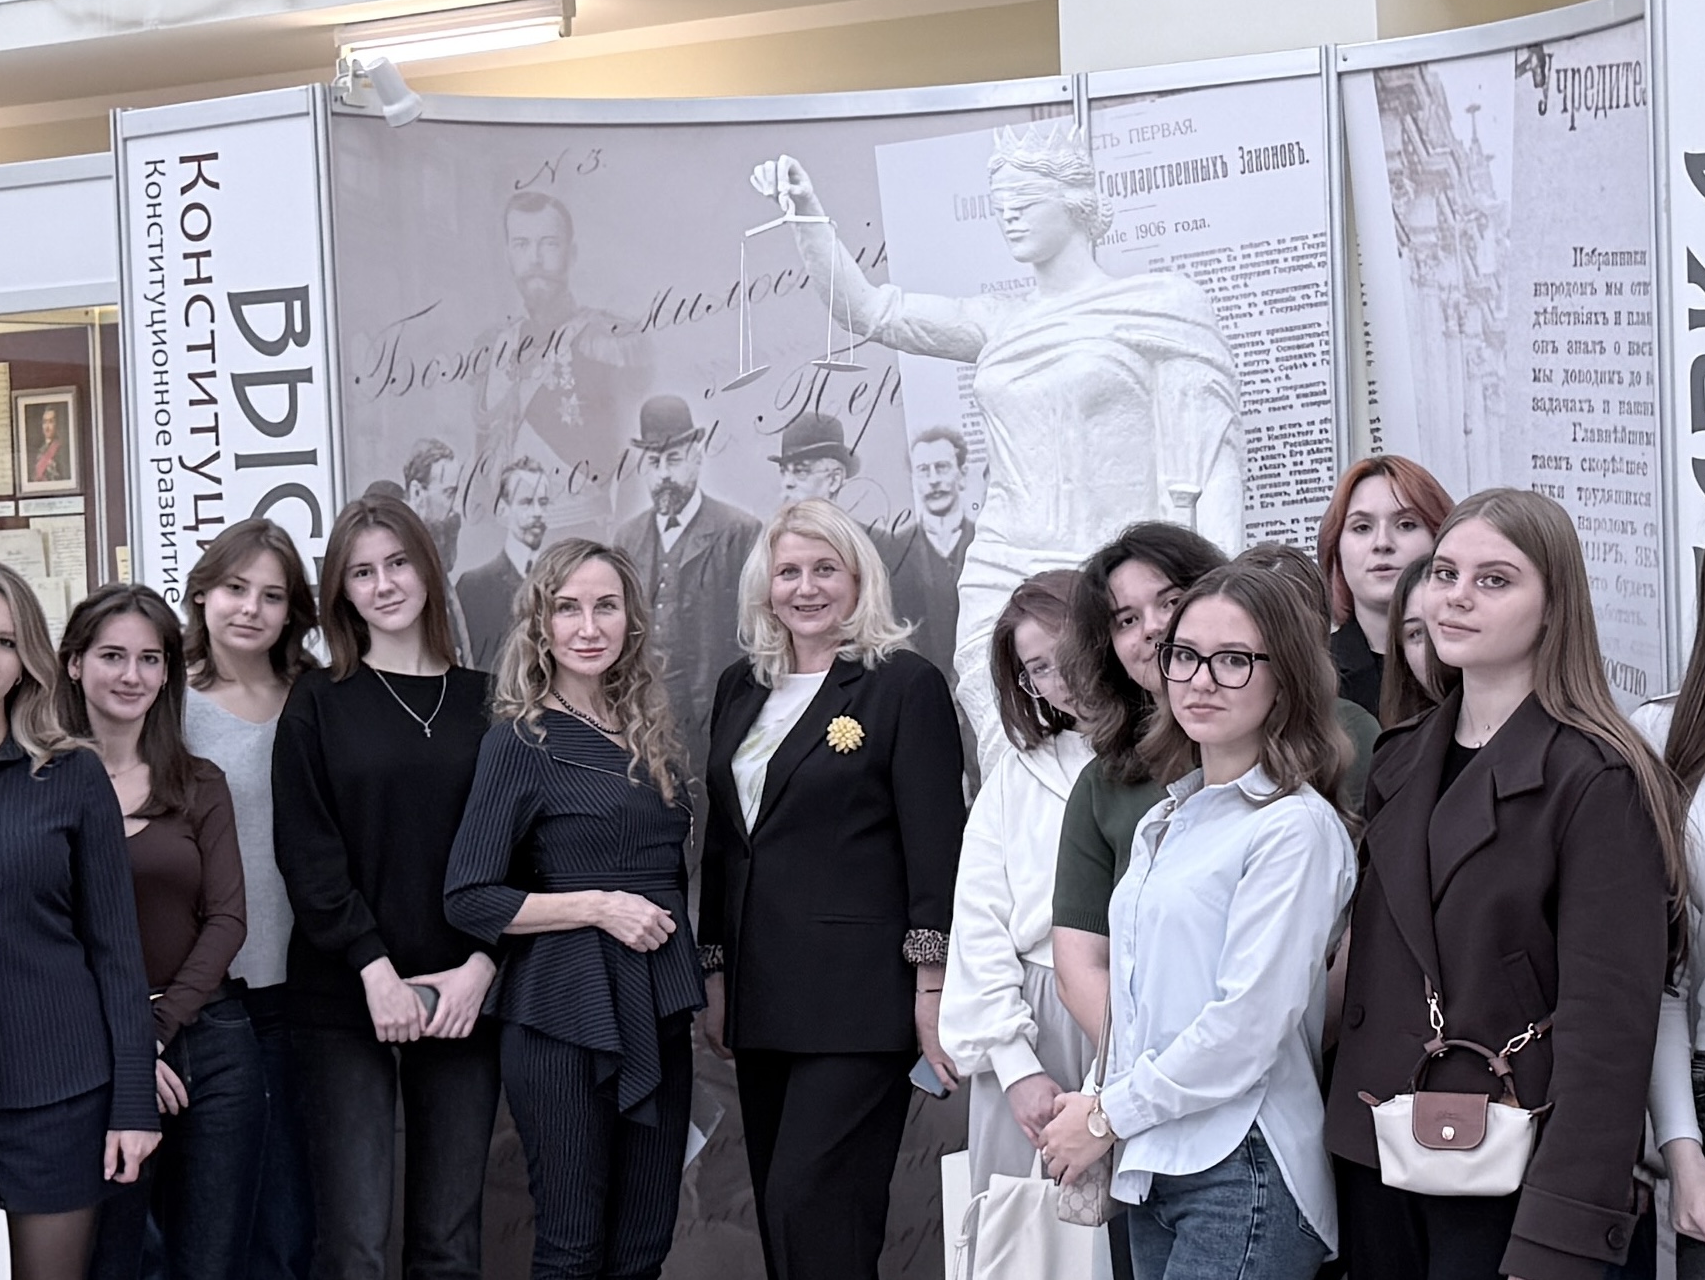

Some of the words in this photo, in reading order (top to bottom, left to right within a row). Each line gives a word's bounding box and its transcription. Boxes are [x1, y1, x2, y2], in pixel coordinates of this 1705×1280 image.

[1128, 117, 1198, 145] ПЕРВАЯ.
[1098, 154, 1229, 200] Государственныхъ
[1238, 141, 1310, 175] Законовъ.
[1135, 220, 1167, 240] 1906
[1174, 217, 1211, 233] года.
[143, 158, 173, 446] Конституционное
[1605, 281, 1623, 296] мы
[1532, 367, 1553, 383] мы
[226, 284, 326, 597] ВЫС
[150, 459, 181, 606] развитие
